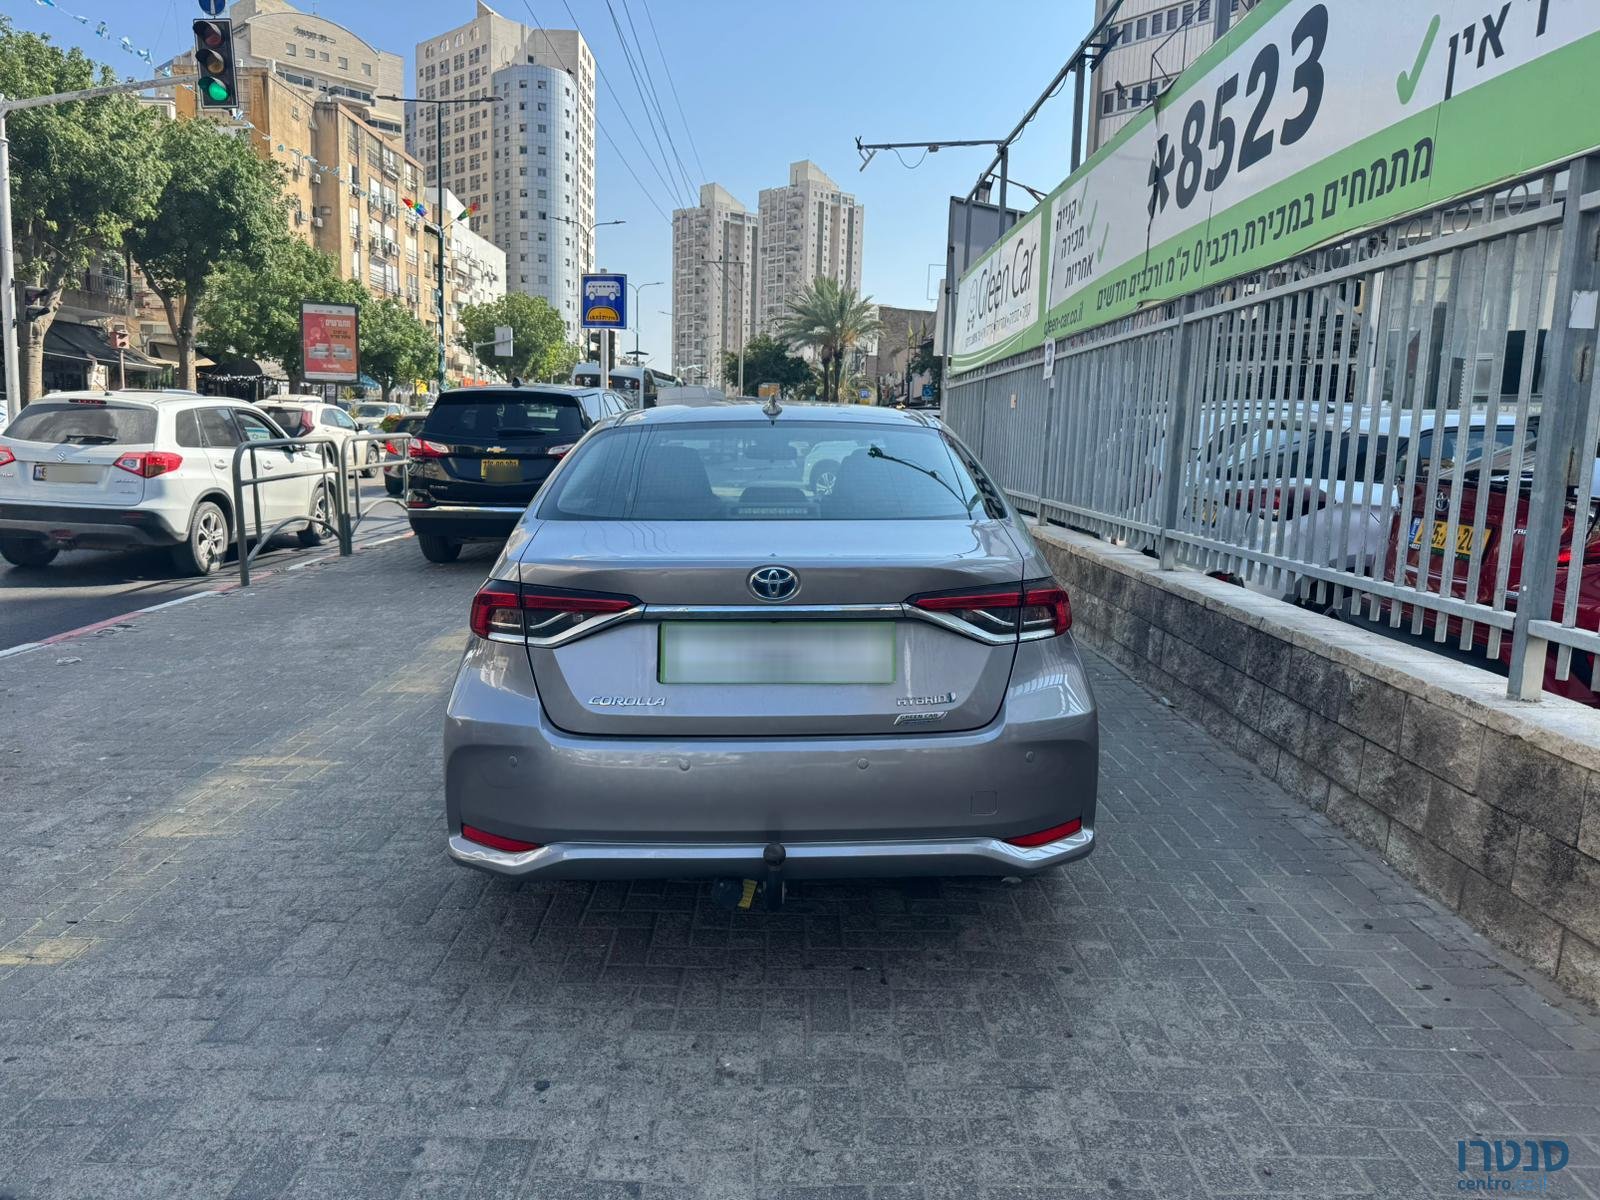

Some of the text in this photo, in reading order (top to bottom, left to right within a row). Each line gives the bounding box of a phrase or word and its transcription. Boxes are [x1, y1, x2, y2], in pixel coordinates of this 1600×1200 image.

[1320, 136, 1433, 221] מתמחים
[1242, 192, 1315, 254] במכירת
[1061, 225, 1085, 260] מכירה
[1193, 240, 1204, 273] 0
[1206, 229, 1239, 267] רכבי
[1011, 237, 1037, 299] Car
[1064, 251, 1095, 289] אחריות
[1129, 261, 1164, 298] ורכבים
[1097, 278, 1128, 311] חדשים
[588, 696, 667, 706] COROLLA
[896, 695, 946, 706] HYBRID
